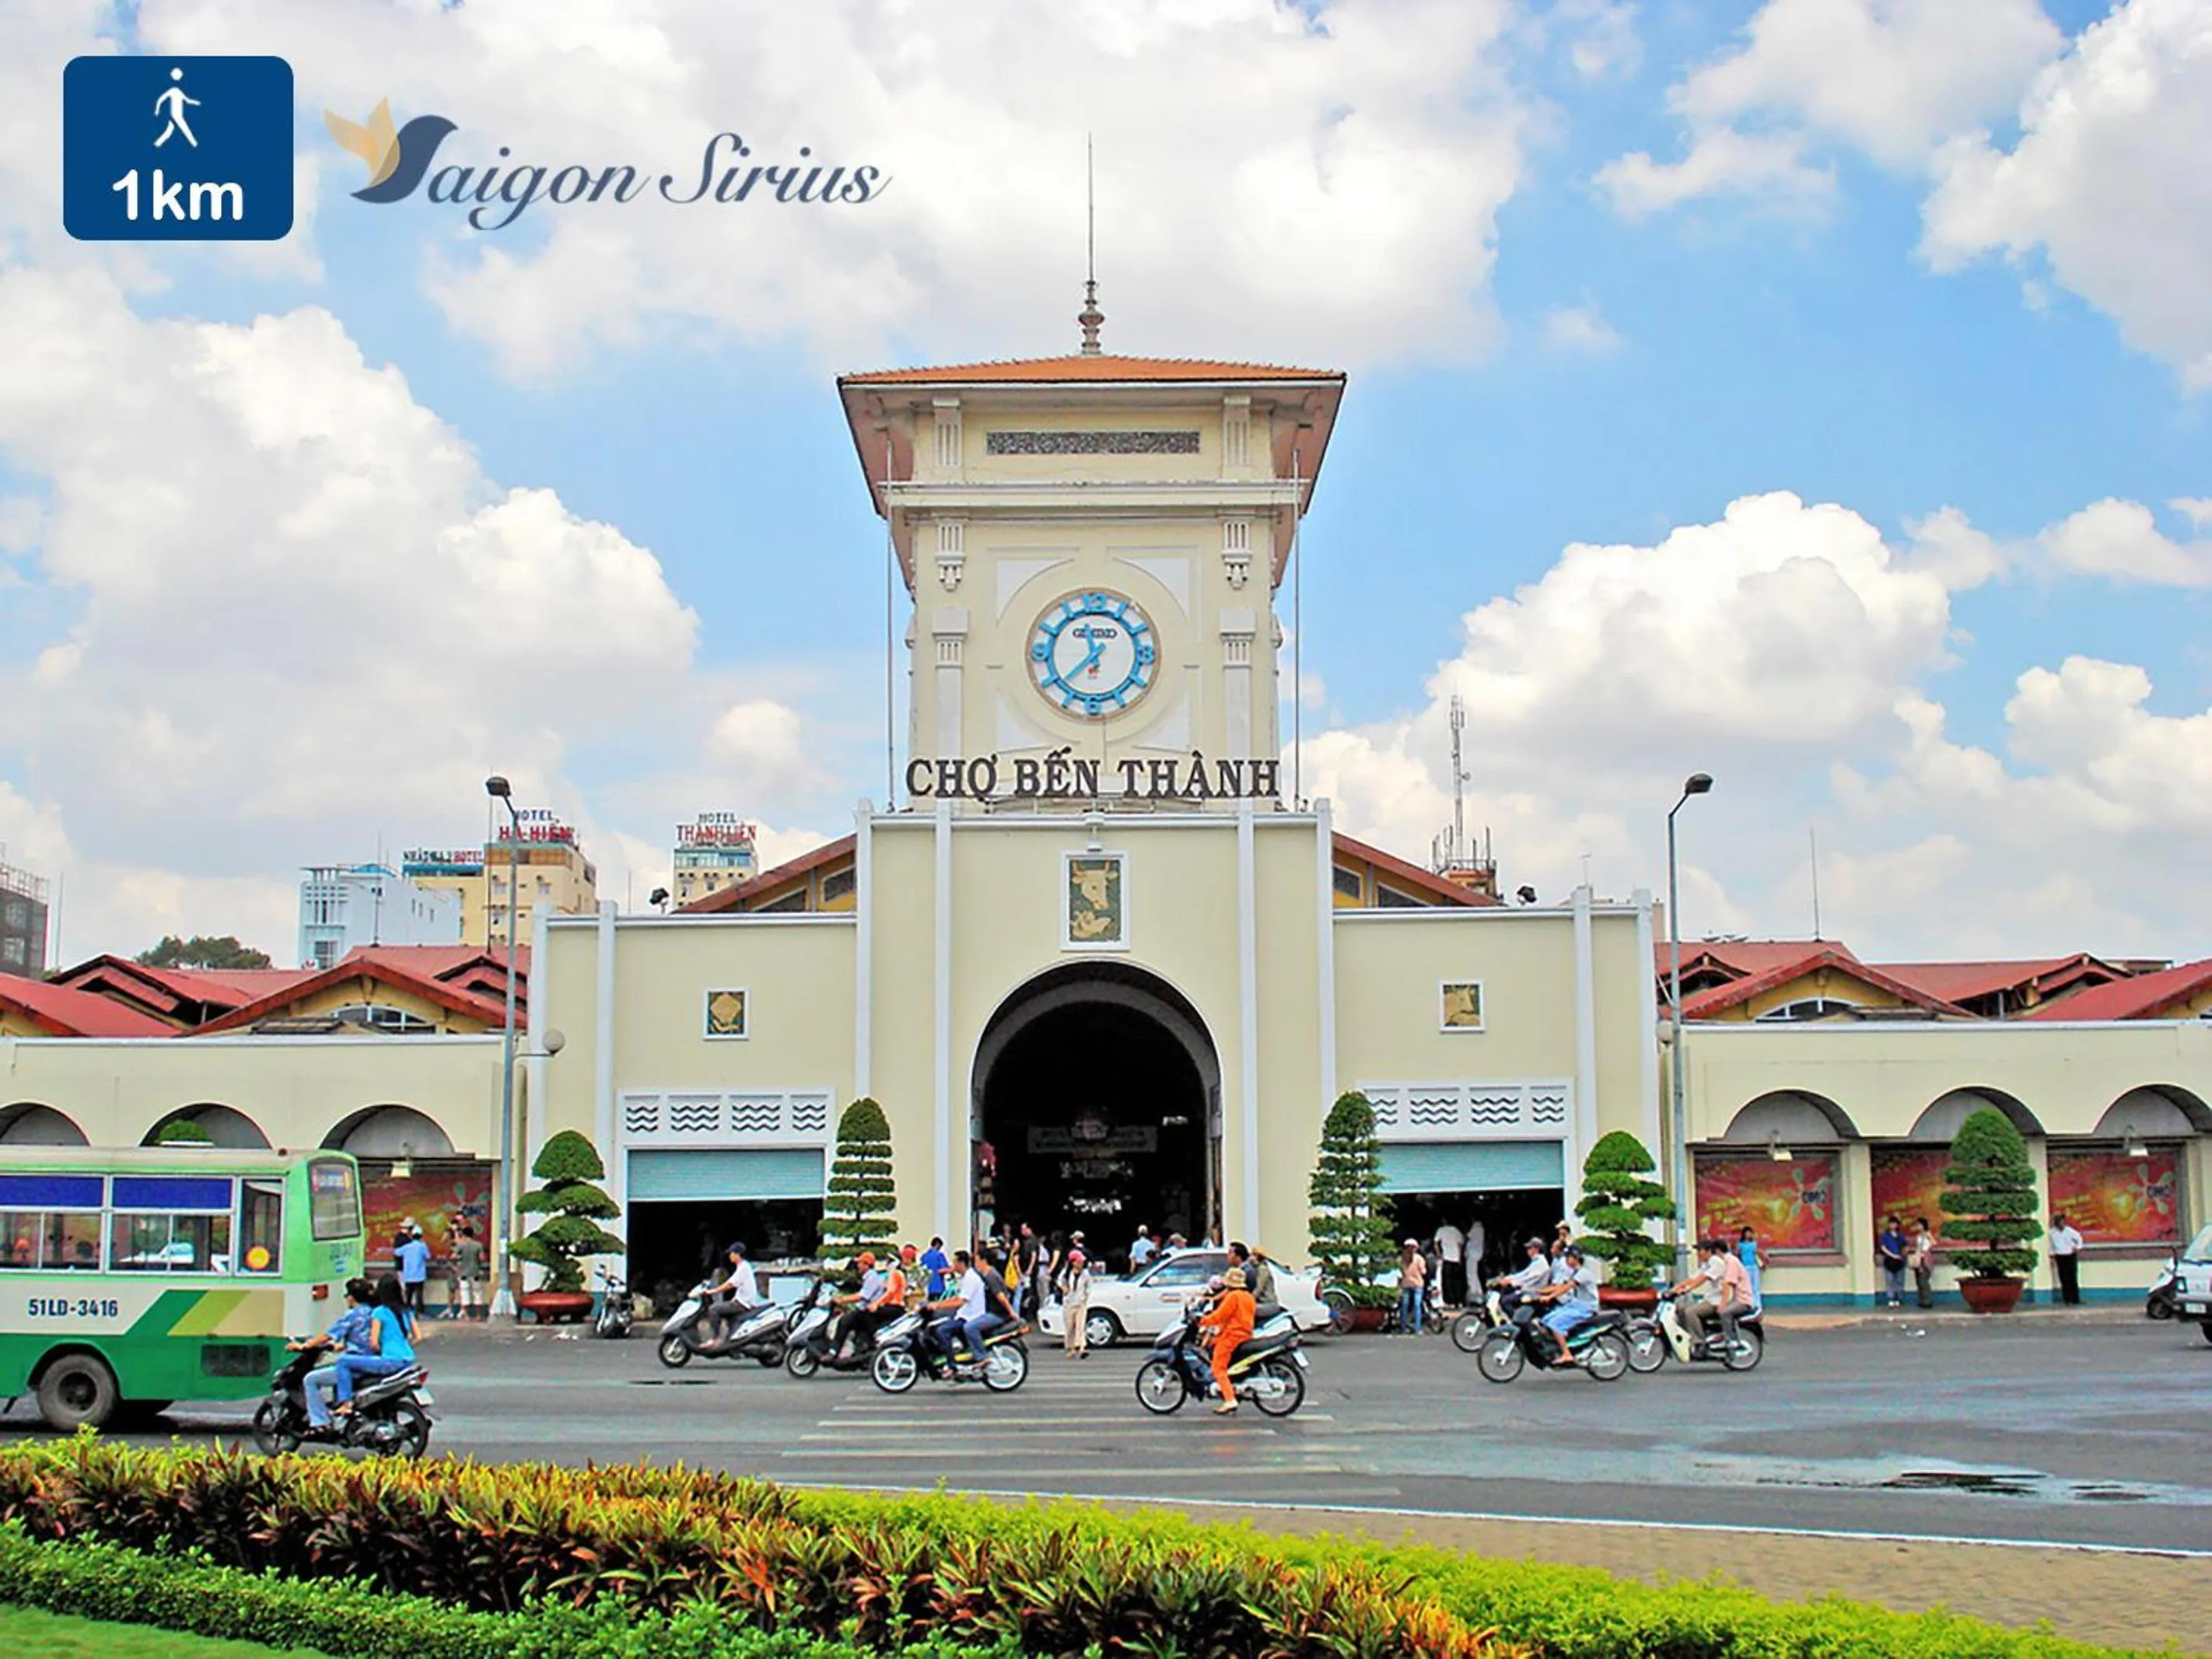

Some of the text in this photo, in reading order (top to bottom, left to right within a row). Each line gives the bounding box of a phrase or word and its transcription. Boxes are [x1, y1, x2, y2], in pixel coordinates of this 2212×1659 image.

[1082, 593, 1108, 612] 12
[906, 747, 1279, 804] CHỢ BẾN THÀNH
[28, 1298, 119, 1317] 51LD-3416
